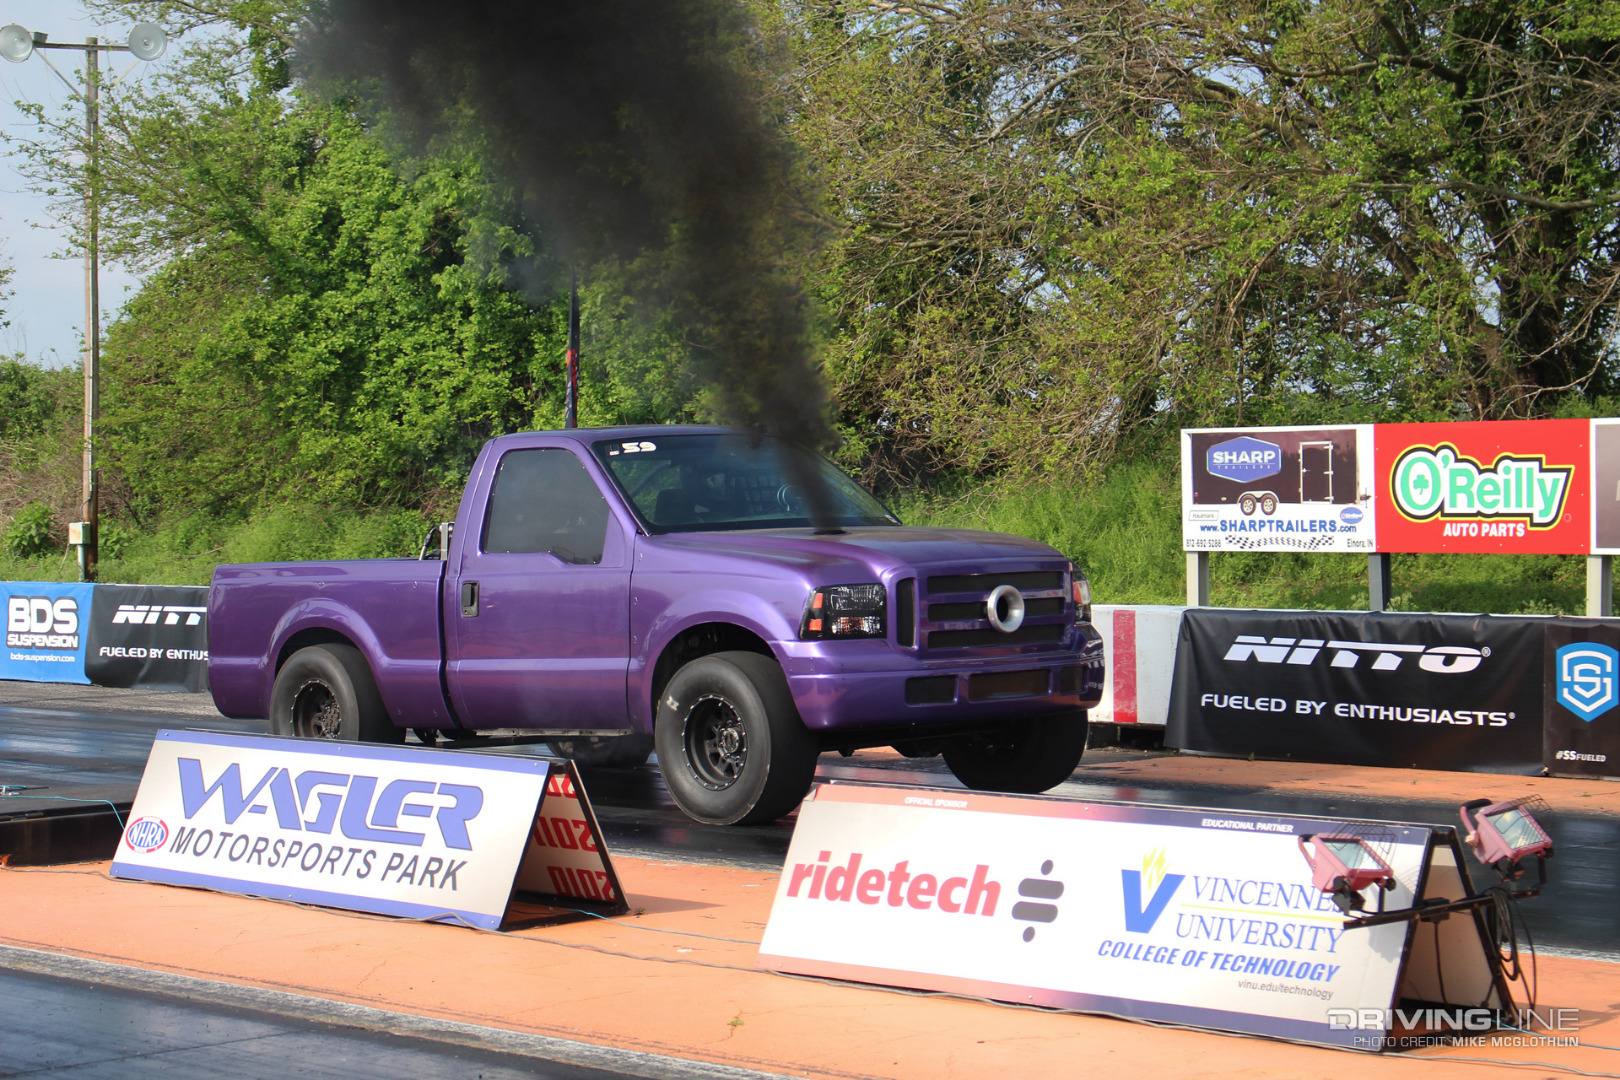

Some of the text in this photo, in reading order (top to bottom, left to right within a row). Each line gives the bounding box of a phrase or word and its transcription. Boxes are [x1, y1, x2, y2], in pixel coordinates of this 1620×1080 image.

[1213, 450, 1275, 464] SHARP
[1401, 454, 1560, 517] O'Reilly
[1200, 520, 1357, 533] www.SHARPTRAILERS.com
[1443, 523, 1525, 537] AUTO PARTS
[8, 598, 78, 634] BDS
[112, 605, 208, 625] NITT
[7, 634, 78, 647] SUSPENSION
[10, 652, 75, 662] bds-suspension.com
[100, 647, 209, 661] FUELED BY ENTHUS
[1201, 694, 1508, 727] FUELED BY ENTHUSIASTS
[177, 757, 484, 851] WAGLER
[130, 822, 164, 847] NHRA
[1202, 818, 1294, 833] EDUCATIONAL PARTNER
[169, 826, 467, 891] MOTORSPORTS PARK
[786, 850, 1001, 917] ridetech
[1176, 913, 1345, 953] UNIVERSITY
[1098, 940, 1341, 982] COLLEGE OF TECHNOLOGY
[1237, 979, 1334, 1000] vinu.edu/technology
